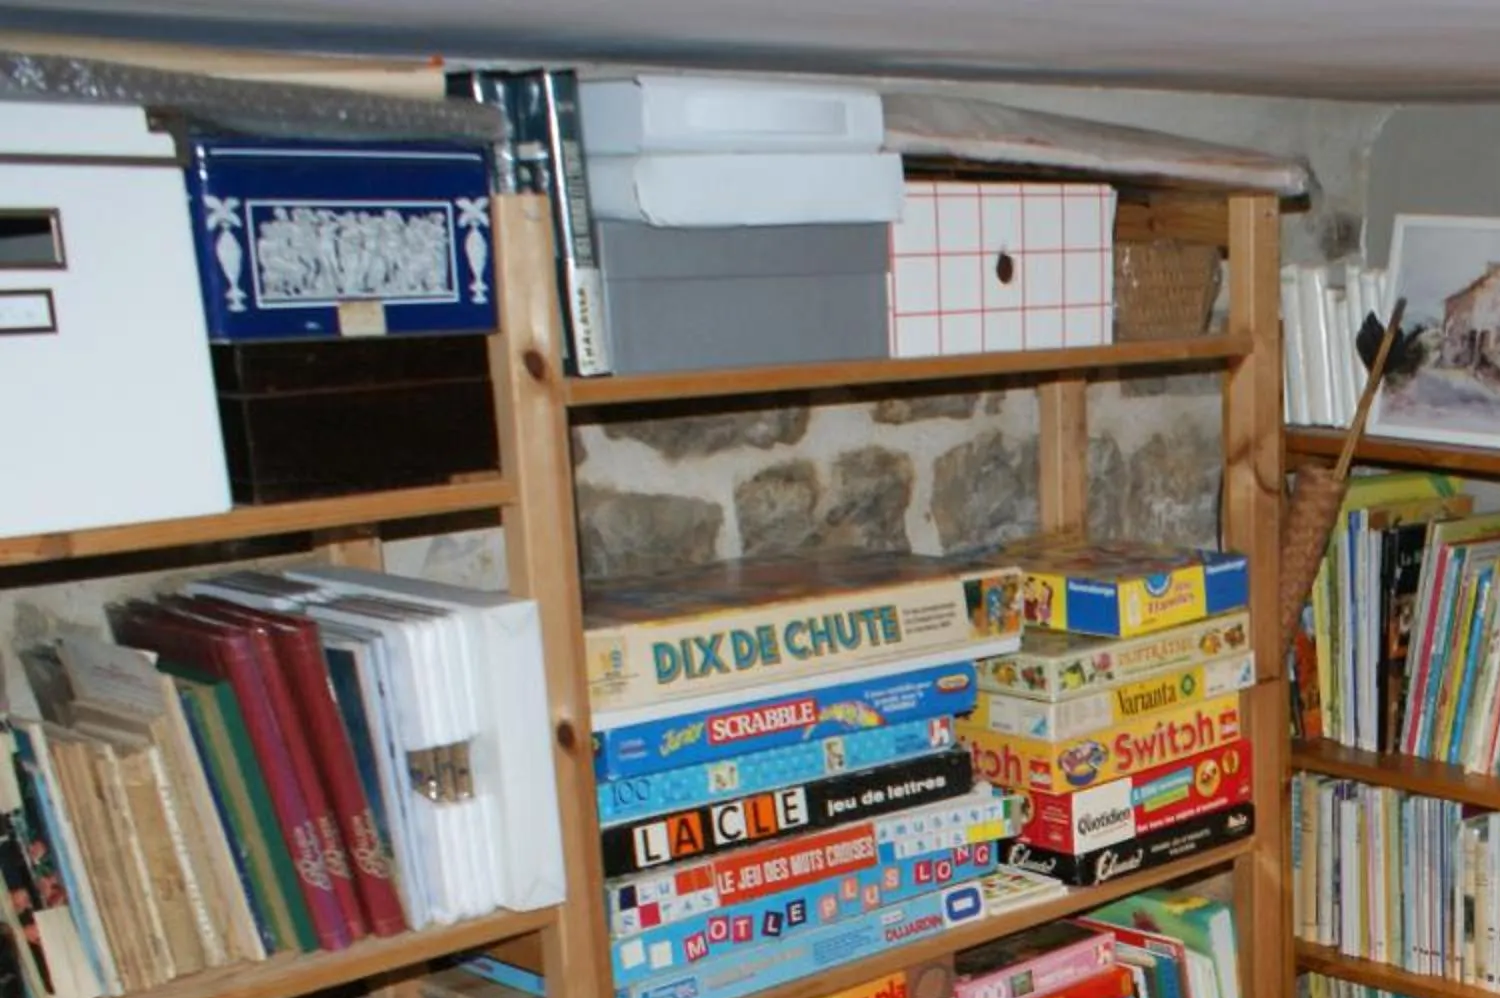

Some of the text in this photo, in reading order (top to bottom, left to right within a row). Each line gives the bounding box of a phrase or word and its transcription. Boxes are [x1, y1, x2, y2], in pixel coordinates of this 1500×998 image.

[652, 630, 731, 685] DIX
[731, 619, 781, 668] DE
[783, 604, 903, 659] CHUTE
[711, 701, 816, 739] SCRABBLE
[610, 778, 651, 808] 100
[888, 774, 946, 800] lettres
[718, 870, 735, 895] LE
[739, 862, 760, 890] JEU
[764, 853, 789, 882] DES
[791, 845, 825, 874] MOTS
[686, 843, 989, 961] MOT LE PLUS LONG
